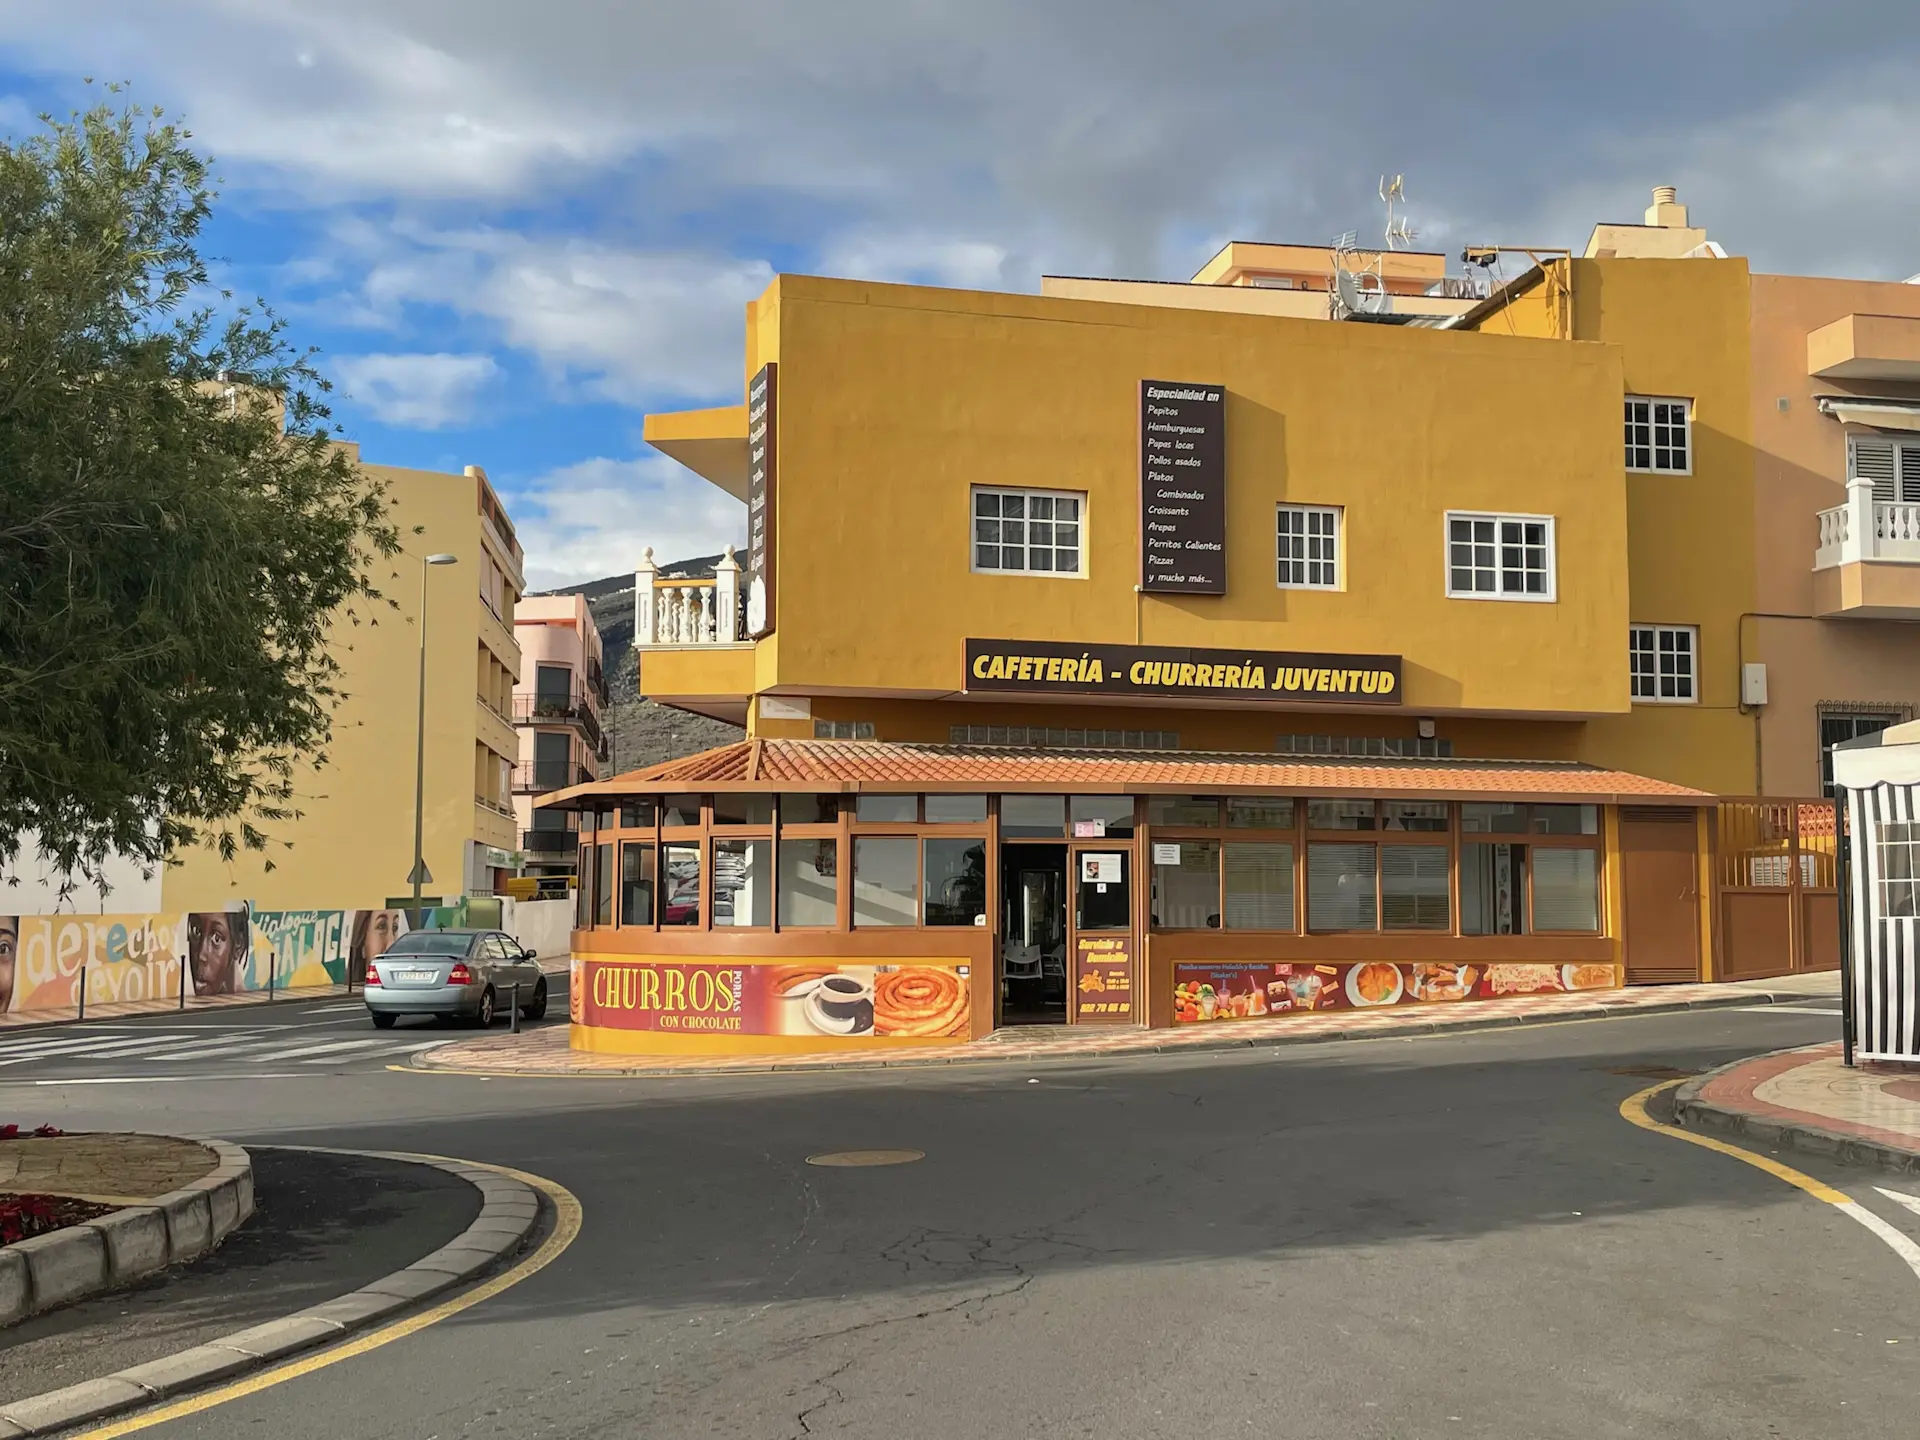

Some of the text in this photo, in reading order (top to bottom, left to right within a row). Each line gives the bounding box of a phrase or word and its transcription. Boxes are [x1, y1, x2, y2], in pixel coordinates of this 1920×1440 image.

[1147, 387, 1220, 402] Especialidad en
[1148, 404, 1178, 416] Pepitos
[1147, 422, 1205, 435] Hamburguesas
[1148, 438, 1194, 450] Papas locas
[1148, 454, 1201, 467] Pollos asados
[1148, 471, 1174, 482] Platos
[1157, 489, 1205, 500] Combinados
[1148, 505, 1189, 516] Croissants
[1148, 522, 1176, 533] Arepas
[1148, 538, 1221, 551] Perritos Calientes
[1148, 554, 1174, 565] Pizzas
[1148, 574, 1154, 583] y
[1158, 573, 1185, 583] mucho
[972, 653, 1395, 694] CAFETERÍA - CHURRERÍA JUVENTUD
[1078, 939, 1114, 949] Servicio
[1086, 952, 1128, 963] Domicilio
[593, 966, 734, 1012] CHURROS
[732, 970, 743, 1012] PORRAS
[660, 1015, 742, 1030] CON CHOCOLATE
